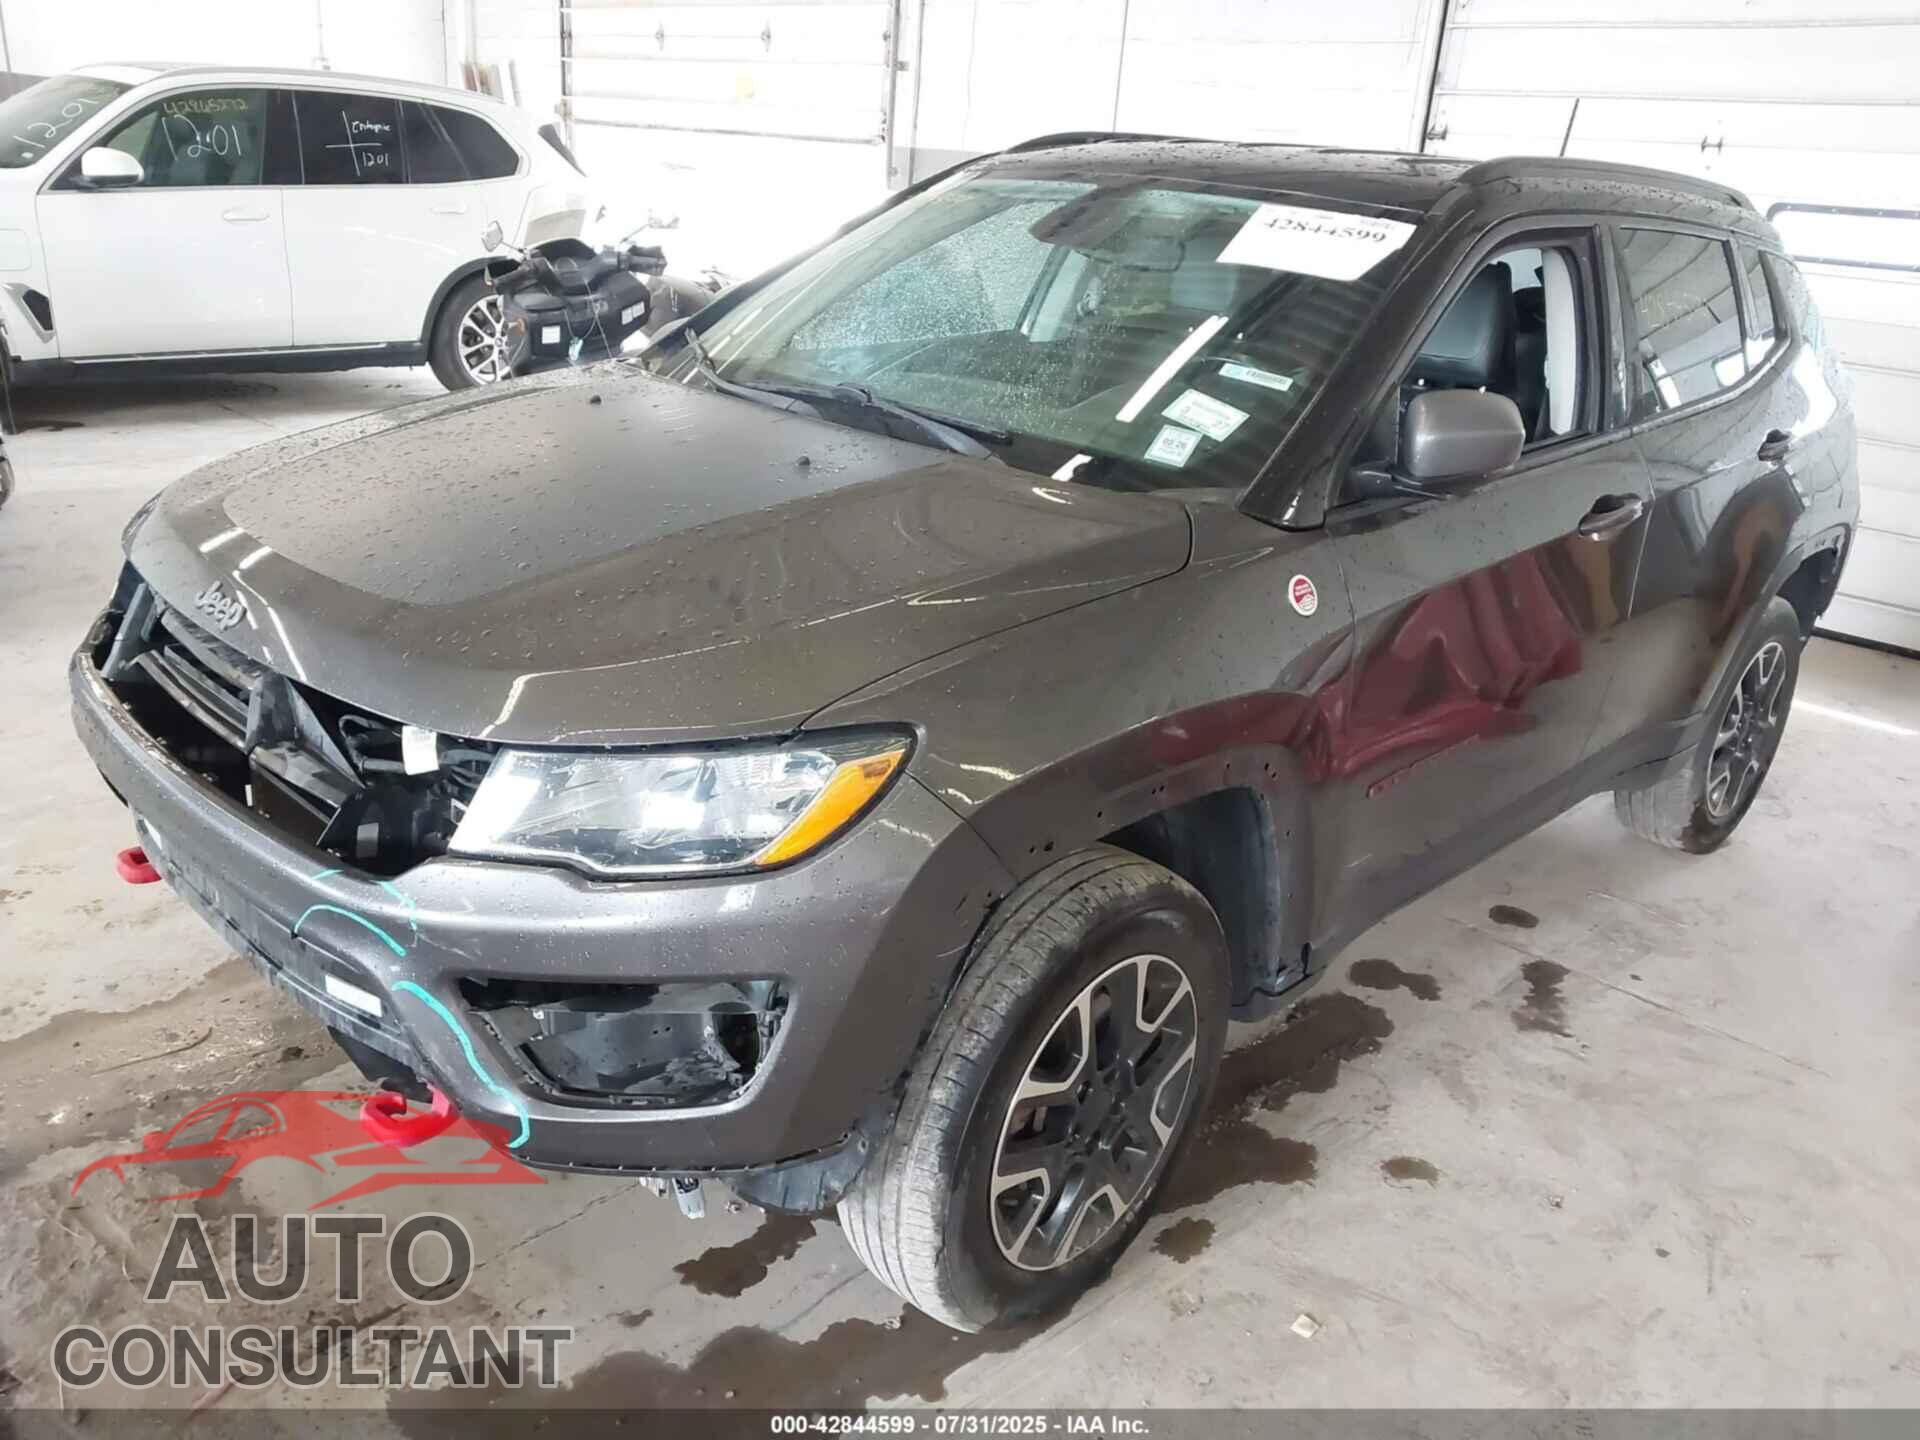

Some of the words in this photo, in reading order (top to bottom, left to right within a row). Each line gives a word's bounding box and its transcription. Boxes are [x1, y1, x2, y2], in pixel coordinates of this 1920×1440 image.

[362, 151, 389, 167] 1201
[1264, 217, 1387, 242] 42844599
[194, 580, 244, 631] Jeep
